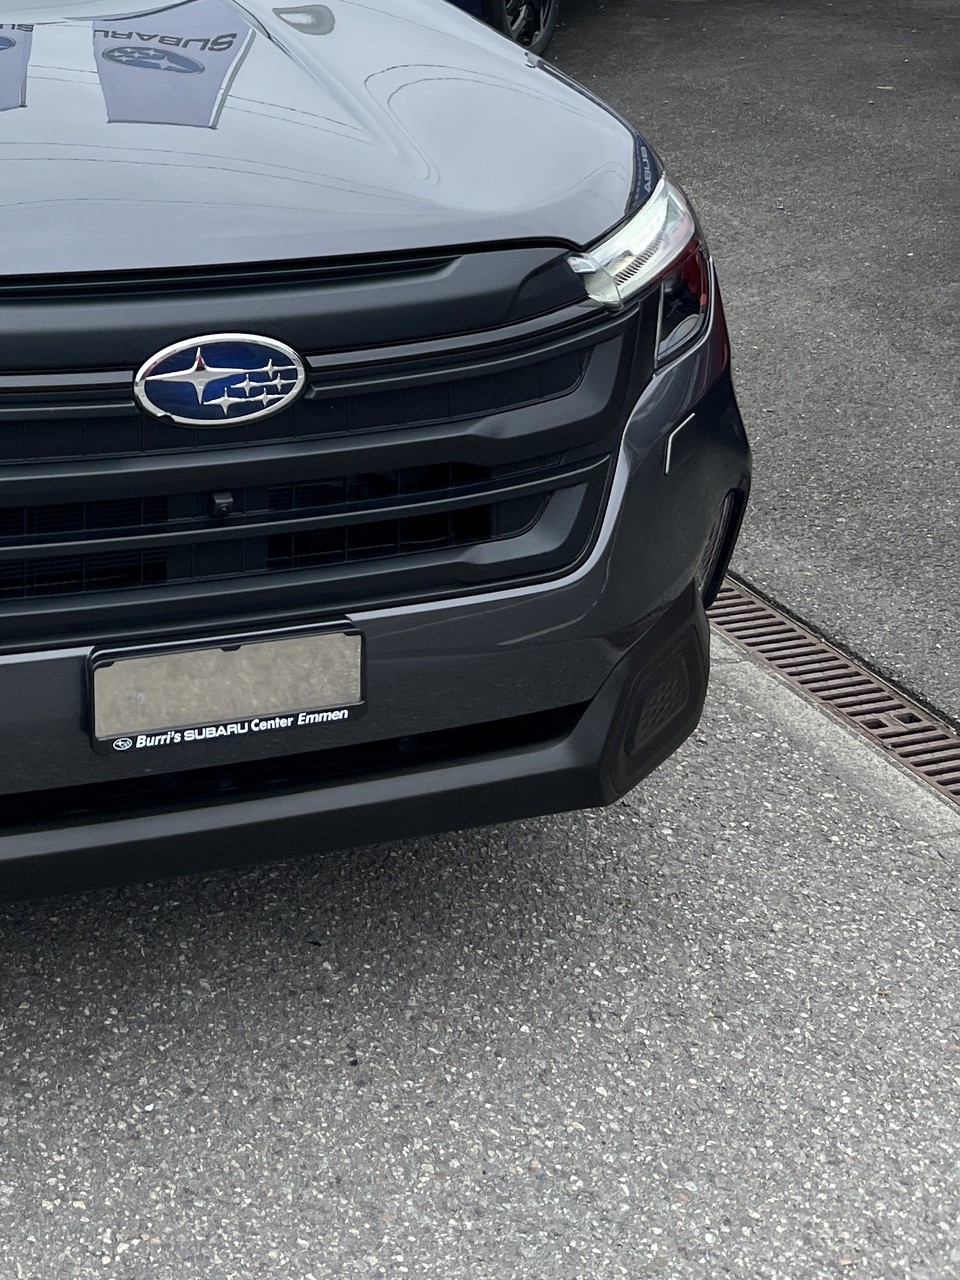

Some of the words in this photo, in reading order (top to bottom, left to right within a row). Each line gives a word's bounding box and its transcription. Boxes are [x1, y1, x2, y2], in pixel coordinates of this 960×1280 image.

[135, 731, 181, 749] Burri's
[184, 721, 248, 742] SUBARU
[250, 715, 293, 732] Center
[297, 709, 349, 726] Emmen
